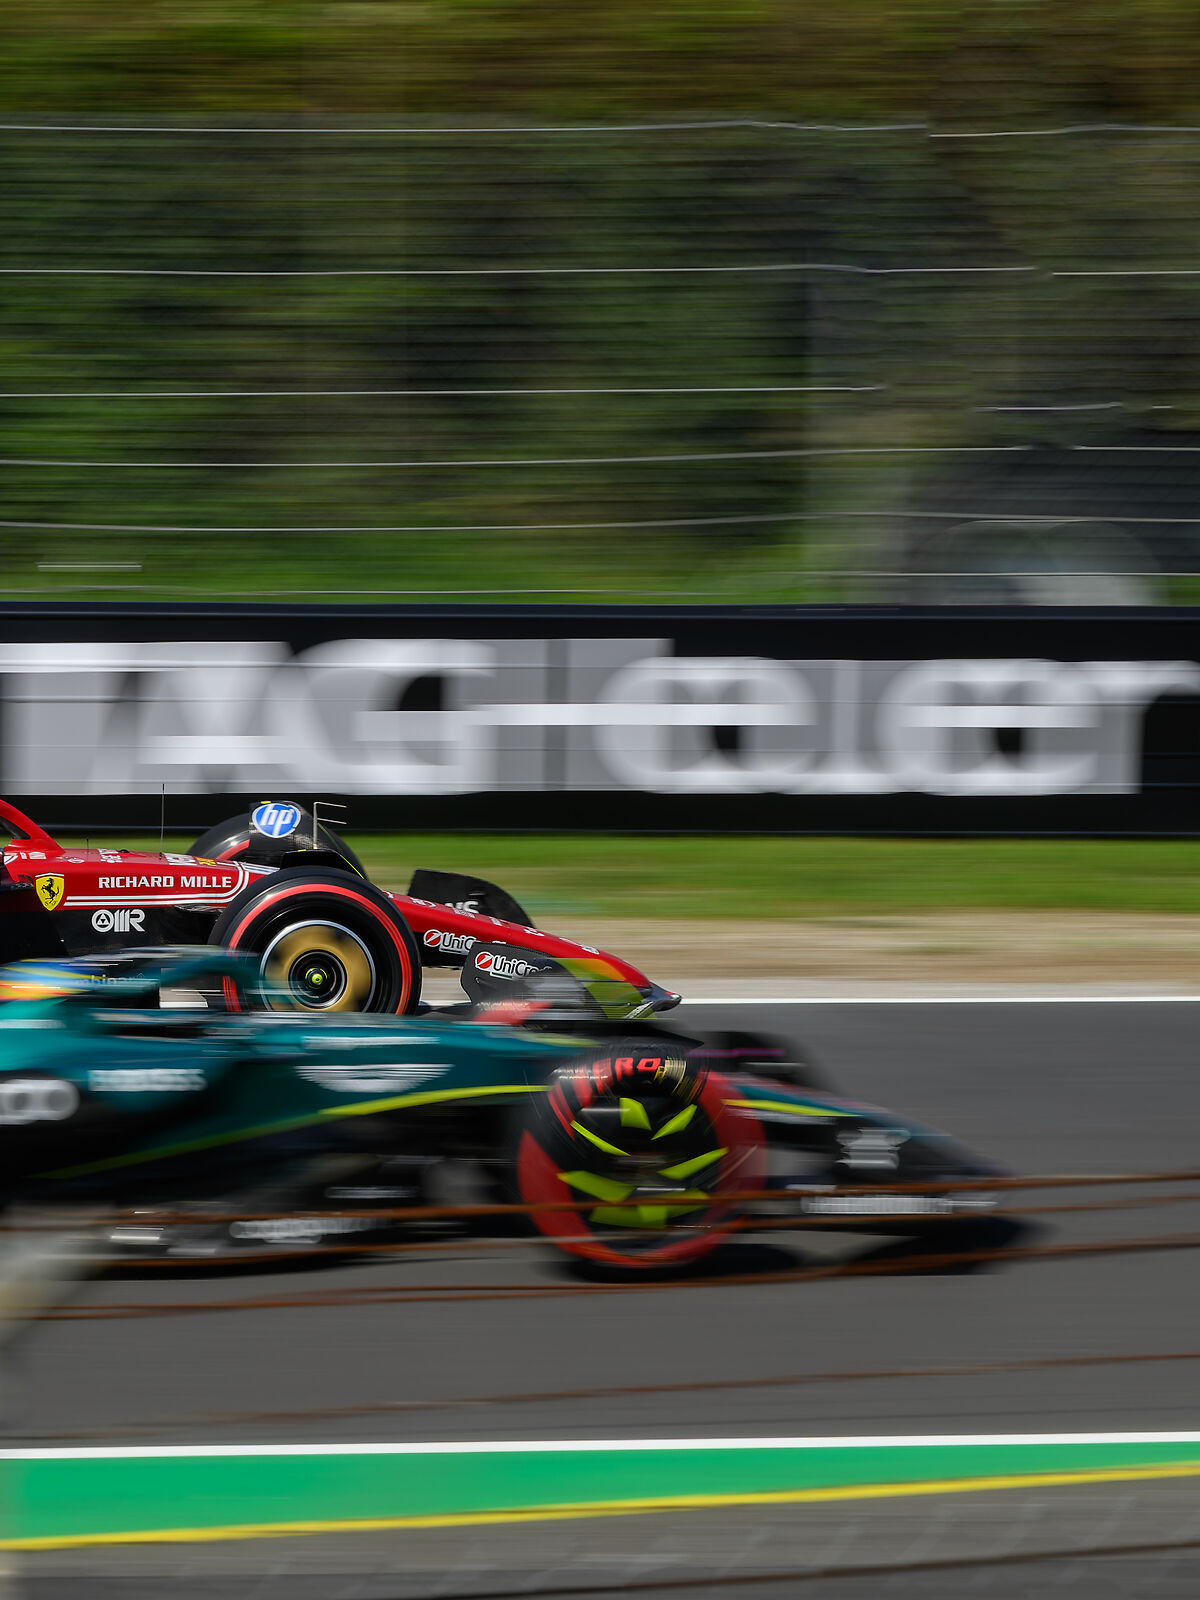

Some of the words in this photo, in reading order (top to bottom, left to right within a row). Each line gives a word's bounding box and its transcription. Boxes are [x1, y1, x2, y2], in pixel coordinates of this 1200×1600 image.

[261, 804, 294, 835] hp
[98, 876, 174, 889] RICHARD
[180, 876, 232, 888] MILLE
